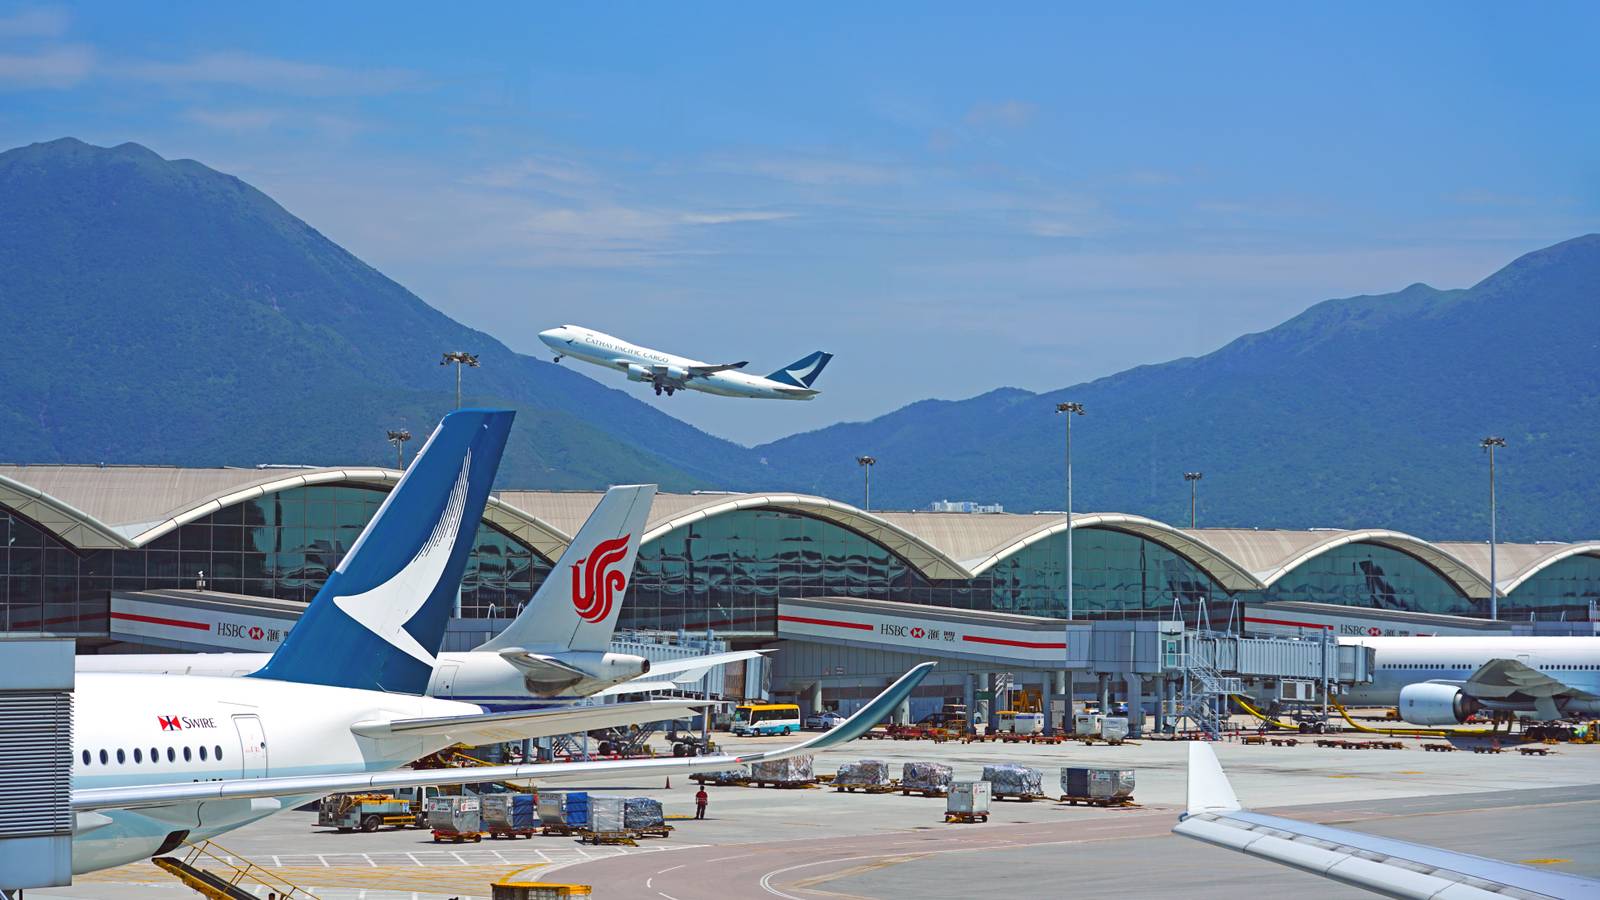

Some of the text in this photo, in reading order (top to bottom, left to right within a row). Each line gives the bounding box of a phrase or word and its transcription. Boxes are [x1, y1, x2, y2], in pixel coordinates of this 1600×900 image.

[585, 337, 669, 363] CATHAY PACIFIC CARGO
[217, 622, 247, 639] HSBC
[880, 623, 909, 638] HSBC
[1340, 623, 1367, 637] HSBC
